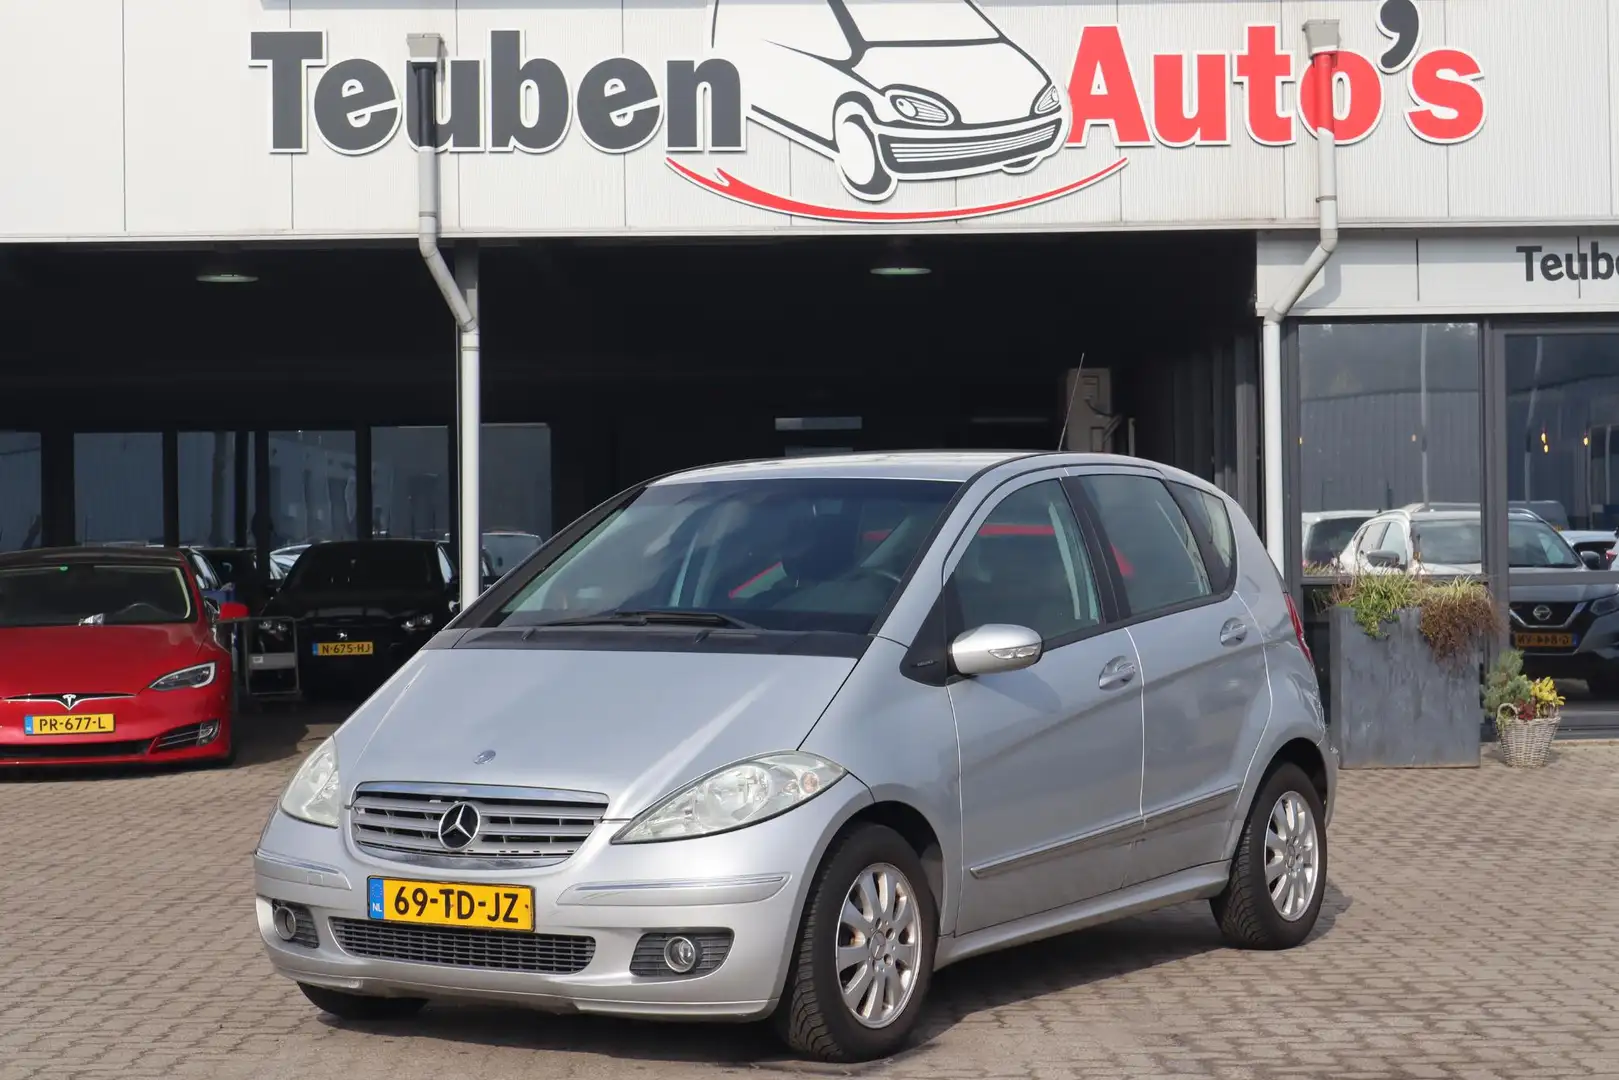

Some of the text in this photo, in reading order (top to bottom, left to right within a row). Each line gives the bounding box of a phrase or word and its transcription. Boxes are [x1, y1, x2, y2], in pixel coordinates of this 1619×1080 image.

[249, 0, 1487, 153] Teuben Auto's
[1515, 240, 1619, 282] Teub
[321, 643, 371, 654] N-675-HJ
[39, 716, 106, 732] PR-677-L
[372, 886, 519, 923] NL 69-TD-JZ
